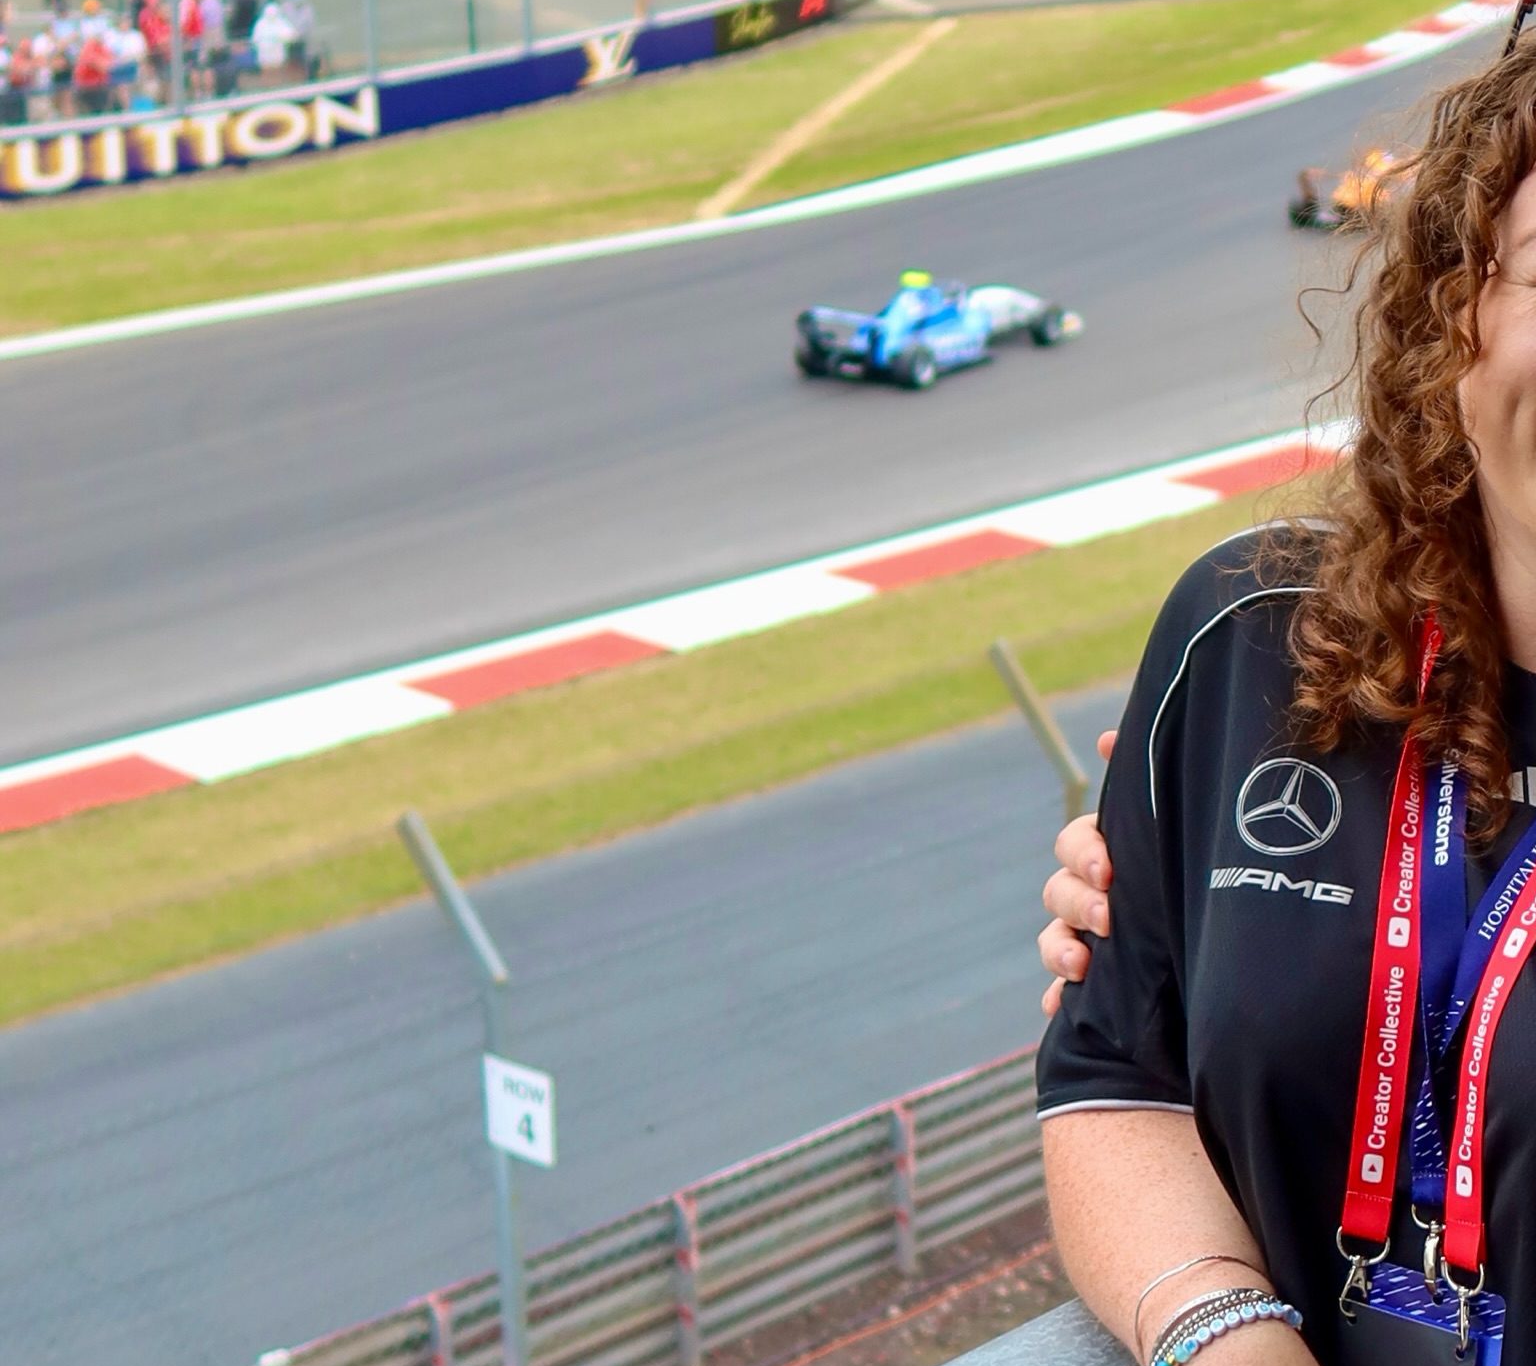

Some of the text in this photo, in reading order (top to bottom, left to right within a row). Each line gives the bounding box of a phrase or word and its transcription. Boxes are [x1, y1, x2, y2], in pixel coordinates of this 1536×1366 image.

[1232, 867, 1355, 906] AMG
[1393, 841, 1416, 913] Creator
[1367, 966, 1405, 1151] Creator Collective
[1458, 975, 1505, 1161] Creator Collective
[503, 1076, 546, 1105] ROW
[517, 1112, 534, 1145] 4
